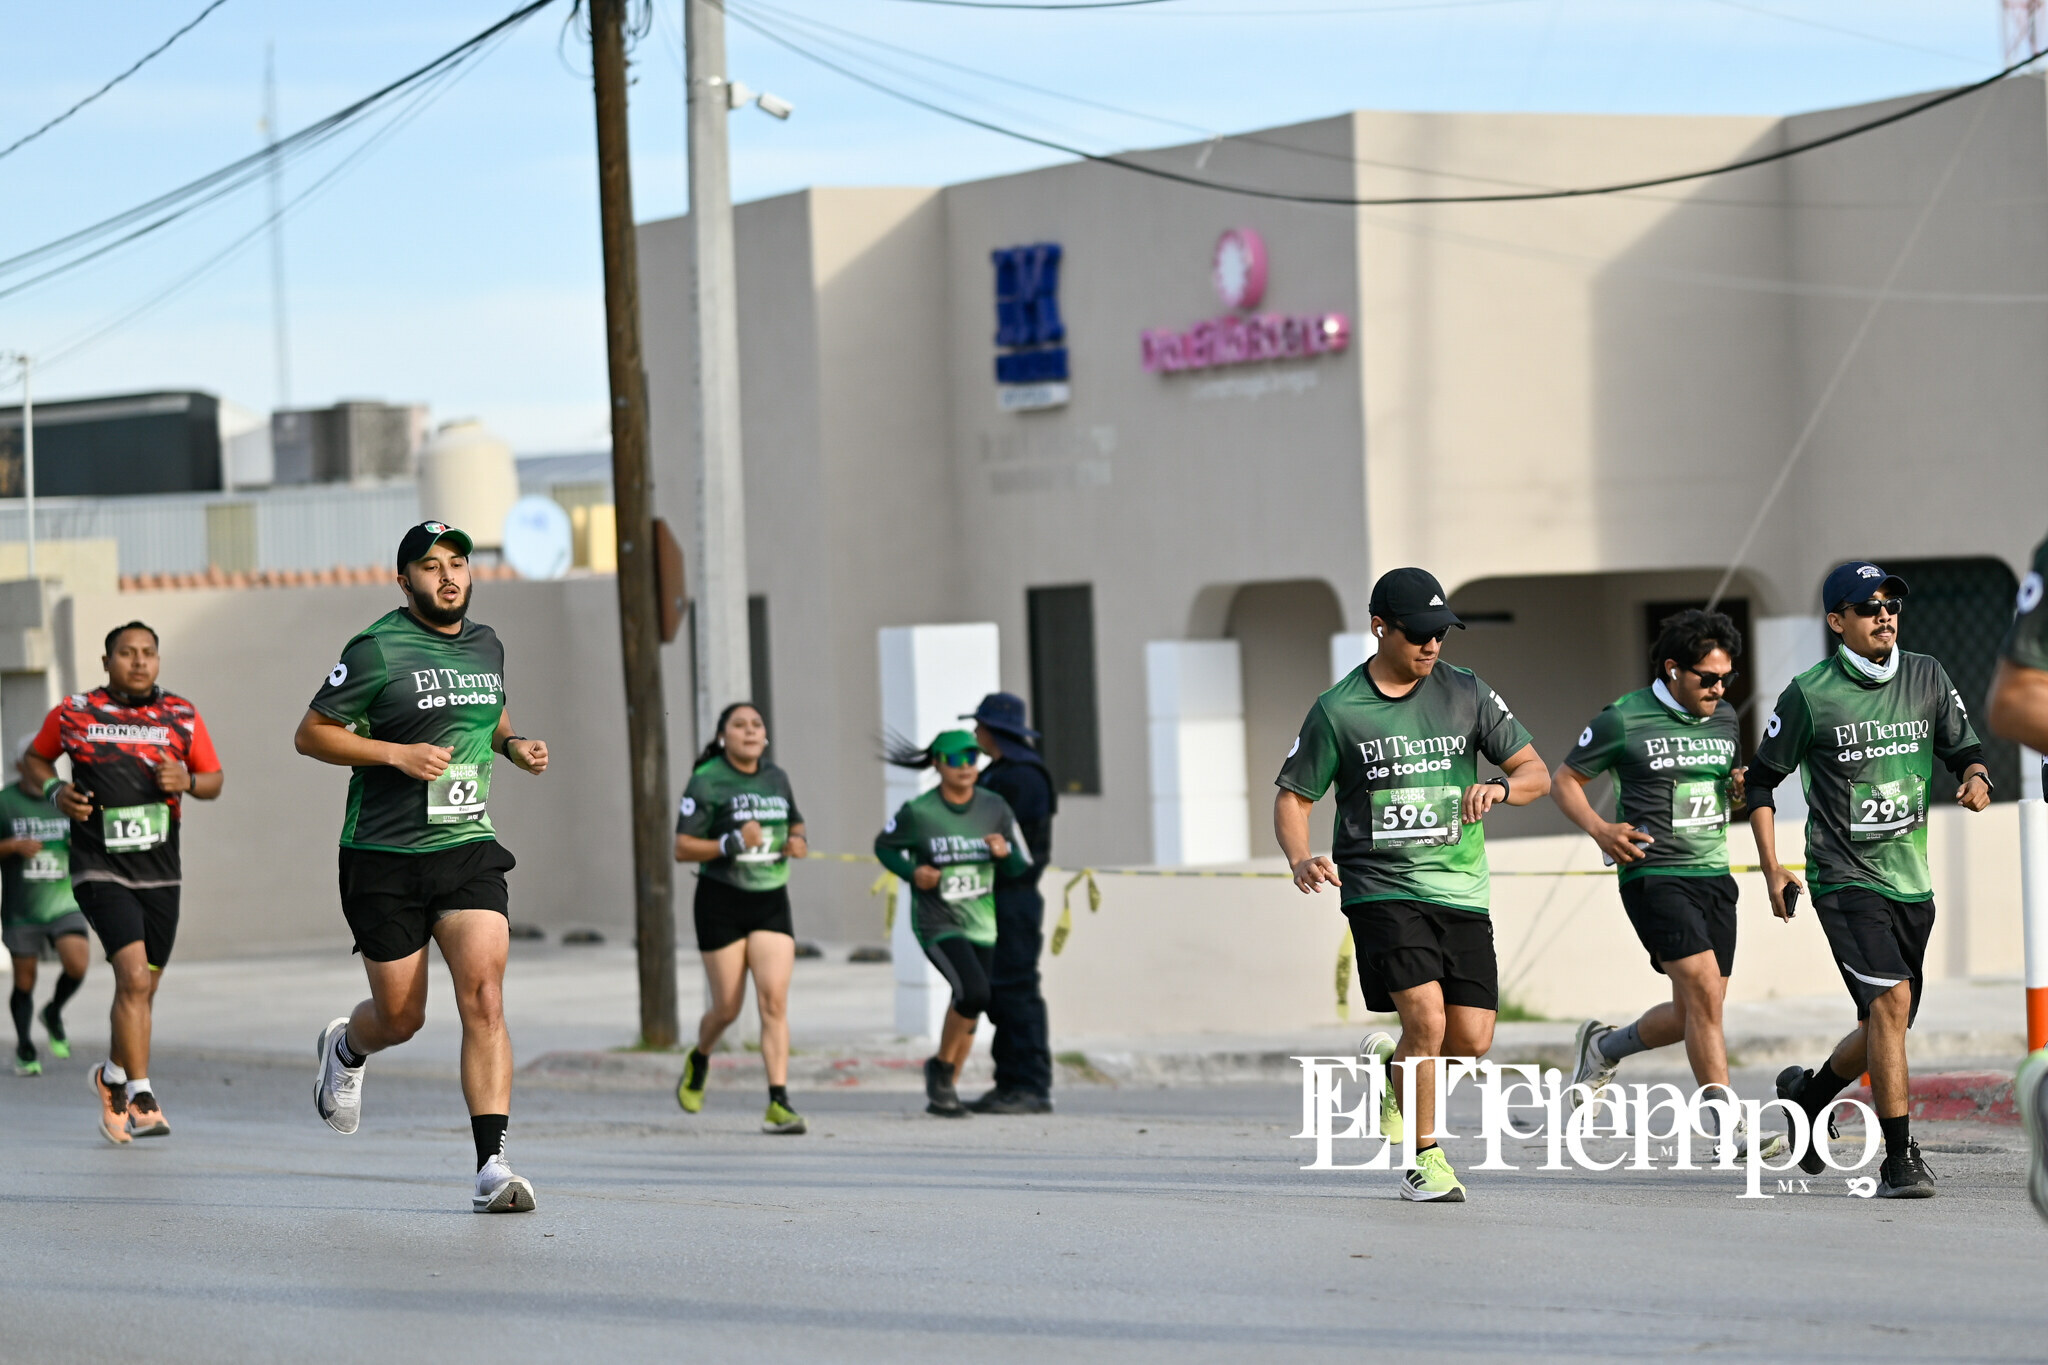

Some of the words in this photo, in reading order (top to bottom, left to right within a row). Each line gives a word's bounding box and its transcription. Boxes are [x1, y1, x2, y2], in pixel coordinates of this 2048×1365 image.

[411, 669, 442, 693] El
[439, 668, 502, 692] Tiempo
[417, 694, 447, 710] de
[448, 691, 498, 706] todos
[1833, 723, 1860, 748] El
[1859, 719, 1929, 742] Tiempo
[1357, 738, 1386, 765] El
[1384, 734, 1467, 758] Tiempo
[1644, 737, 1671, 757] El
[1670, 736, 1736, 757] Tiempo
[1837, 748, 1863, 762] de
[1864, 741, 1919, 758] todos
[1366, 765, 1390, 781] de
[1391, 758, 1452, 776] todos
[1649, 757, 1675, 771] de
[1676, 752, 1727, 767] todos
[448, 780, 478, 806] 62
[1916, 785, 1924, 822] MEDALLA
[1382, 803, 1438, 830] 596
[1451, 799, 1459, 837] MEDALLA
[1690, 795, 1716, 818] 72
[1860, 795, 1910, 823] 293
[113, 817, 151, 838] 161
[947, 874, 981, 894] 231
